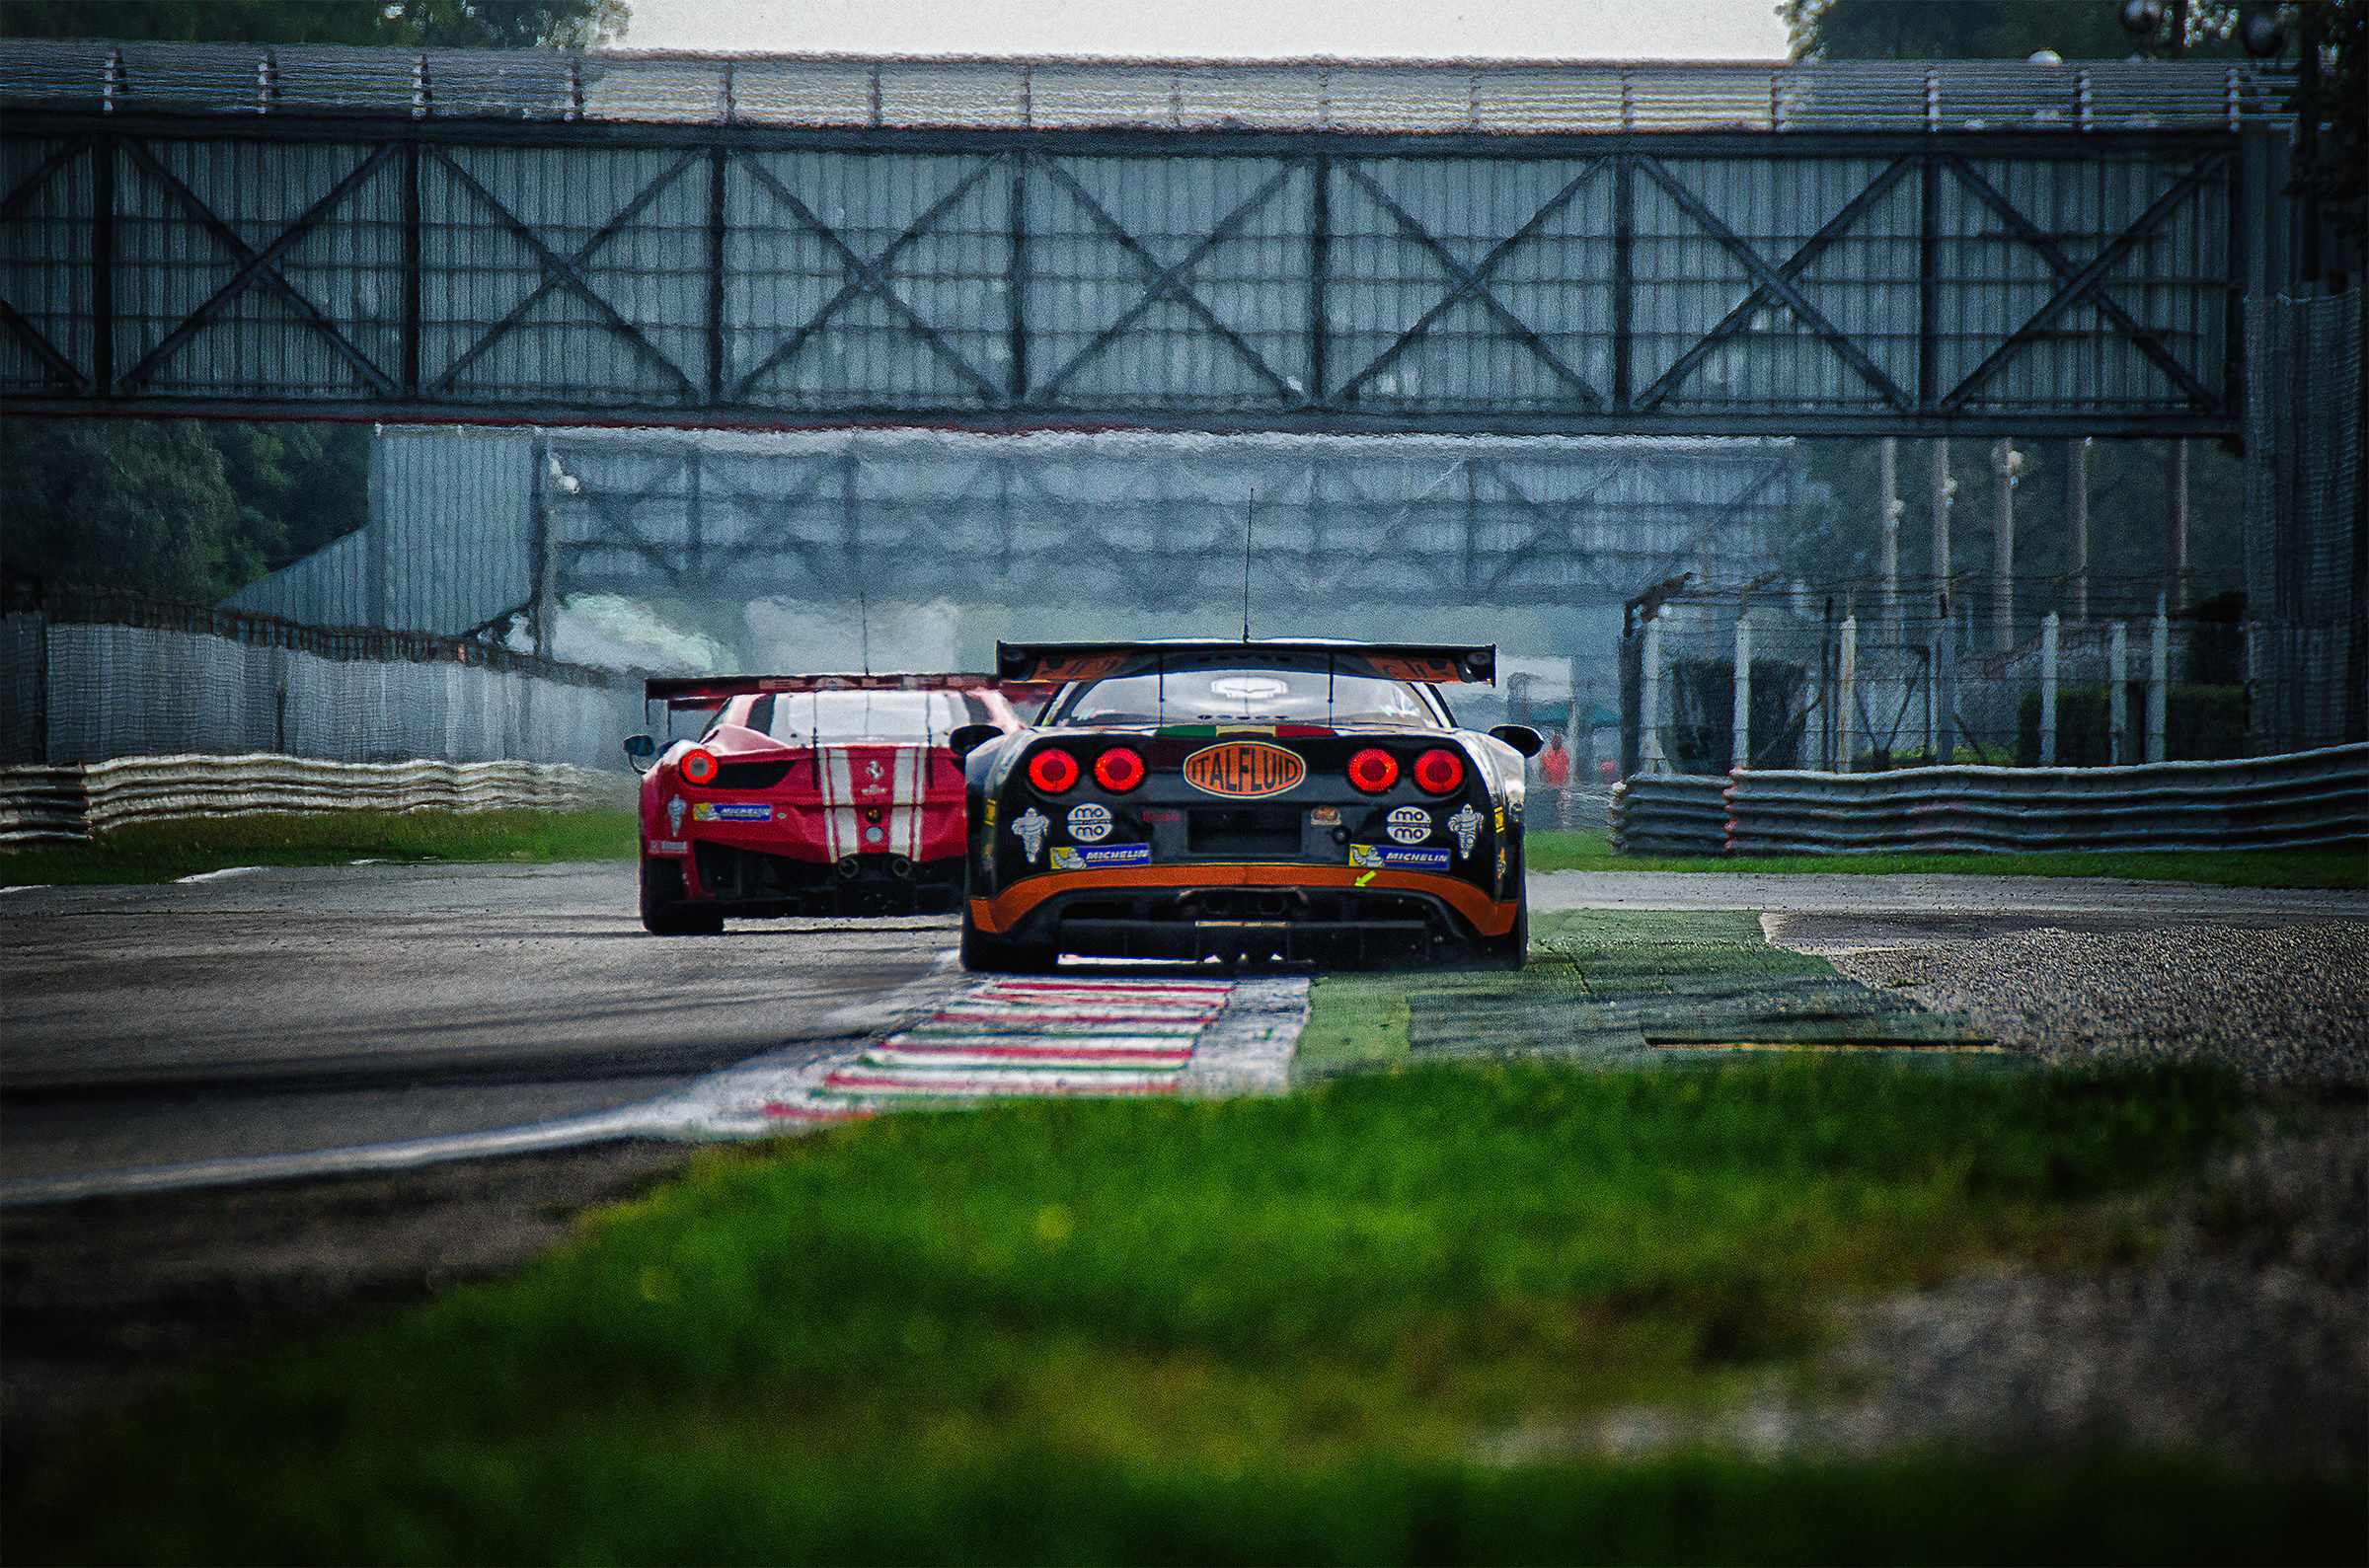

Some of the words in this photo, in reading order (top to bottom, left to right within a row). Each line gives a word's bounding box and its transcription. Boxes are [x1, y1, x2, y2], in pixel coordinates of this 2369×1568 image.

[1191, 747, 1298, 792] ITALFLUID
[1087, 849, 1149, 860] MICHELIN
[1386, 852, 1448, 862] MICHELIN
